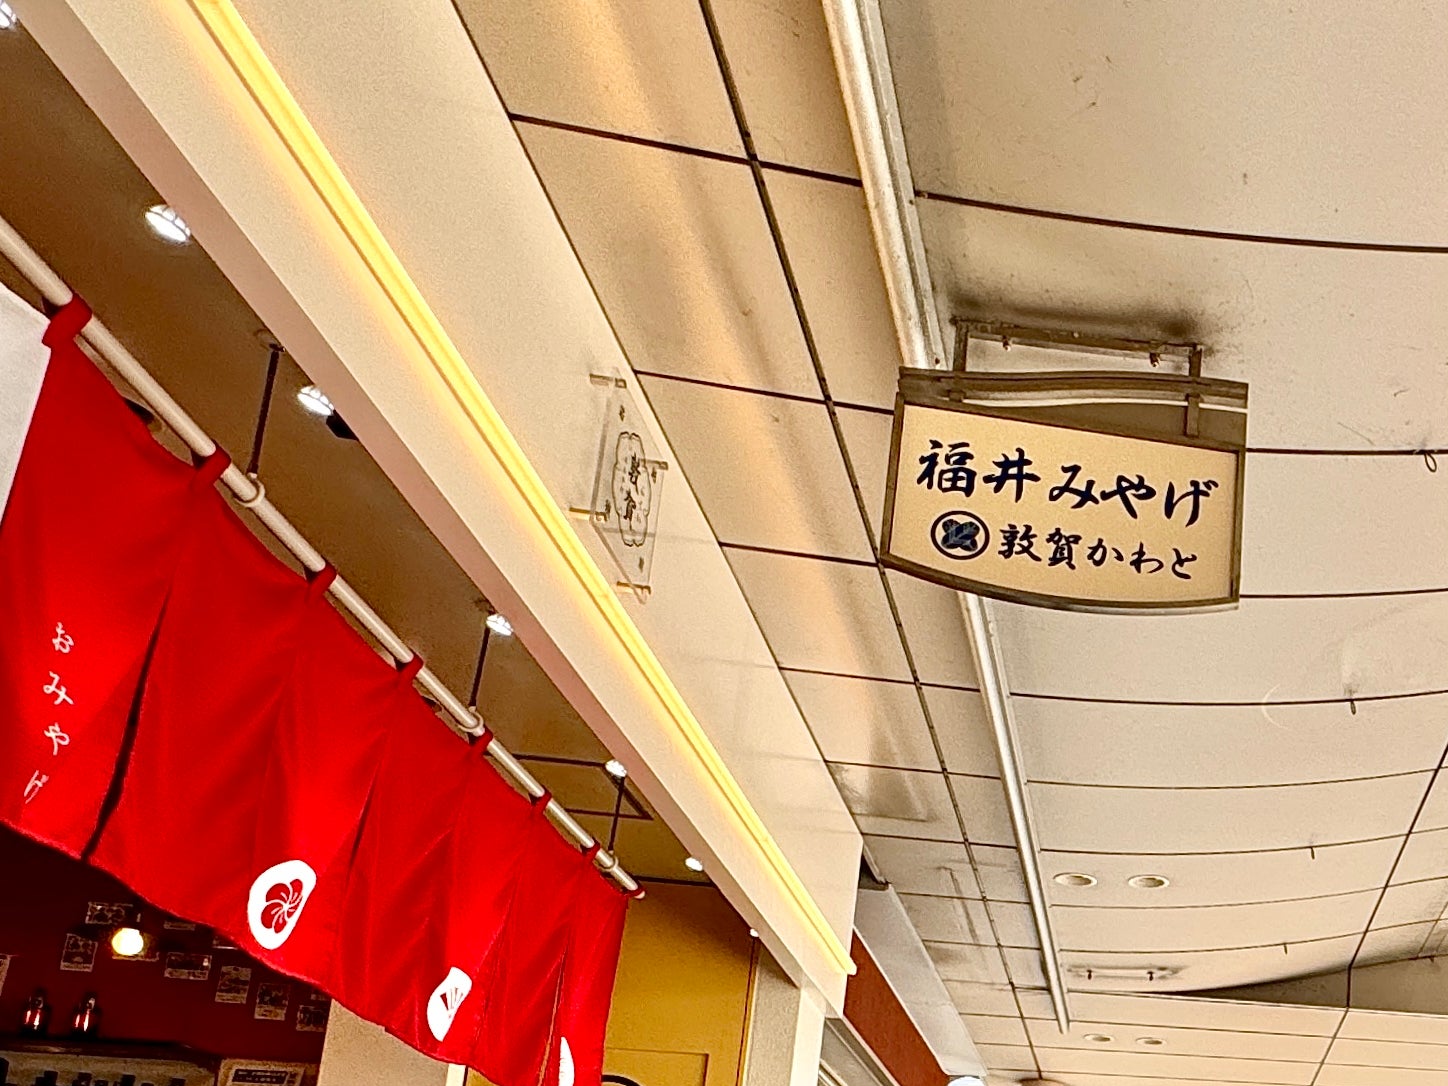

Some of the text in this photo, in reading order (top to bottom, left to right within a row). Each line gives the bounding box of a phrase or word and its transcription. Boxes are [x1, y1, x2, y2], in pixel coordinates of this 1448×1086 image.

[917, 439, 1219, 527] 福井みやげ
[997, 523, 1198, 580] 敦賀かわと
[23, 621, 75, 805] おみやげ
